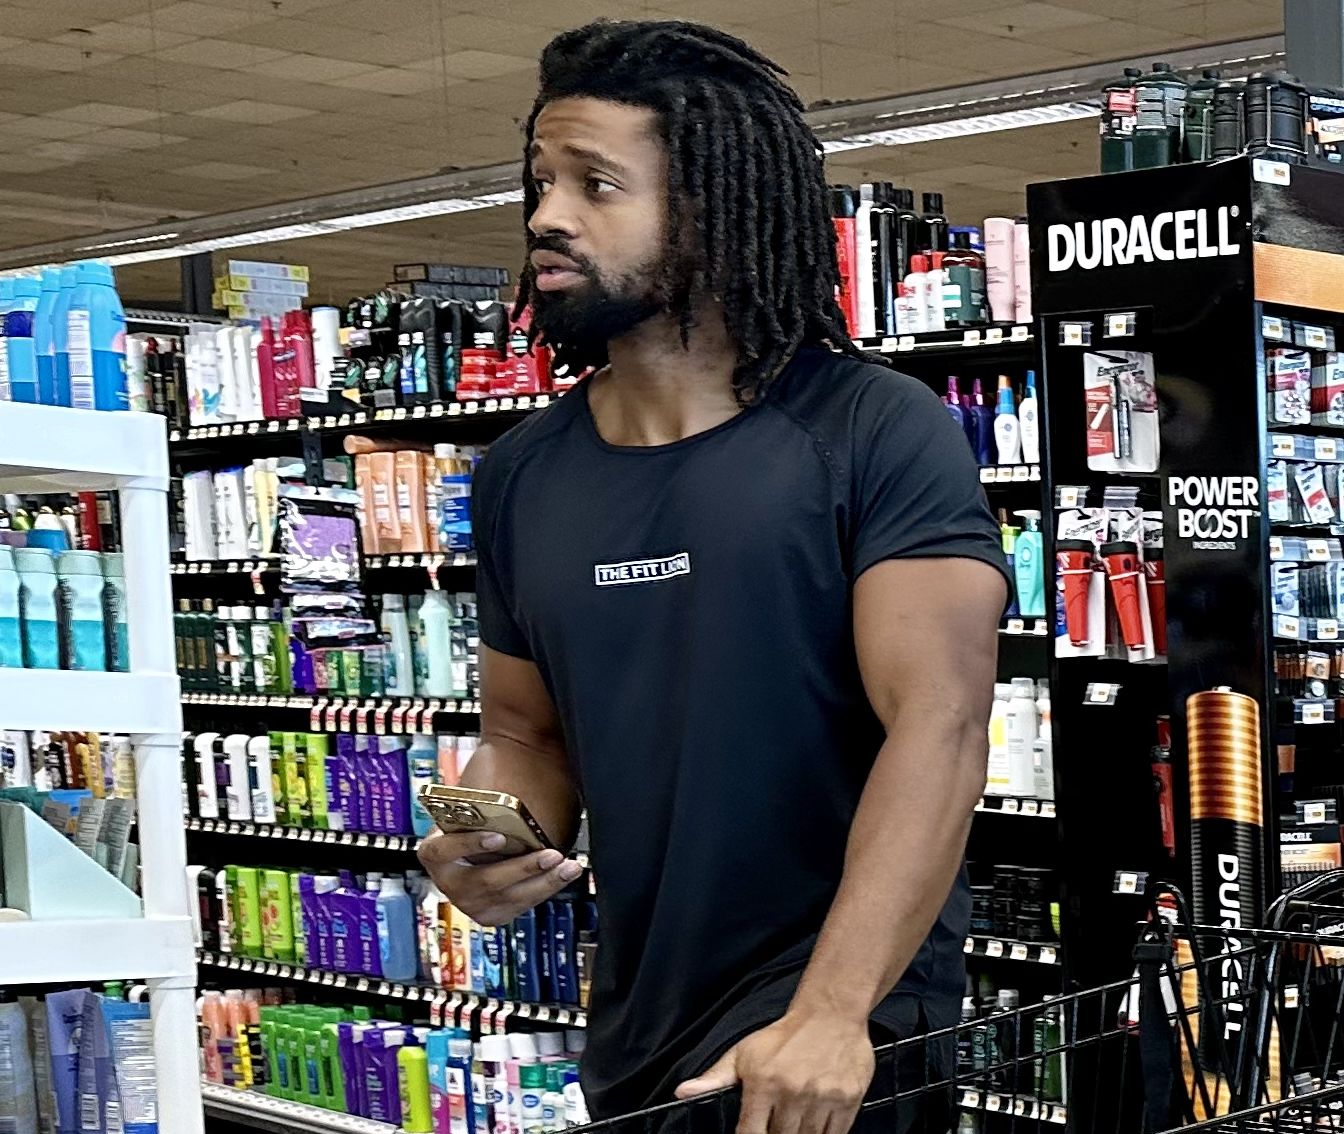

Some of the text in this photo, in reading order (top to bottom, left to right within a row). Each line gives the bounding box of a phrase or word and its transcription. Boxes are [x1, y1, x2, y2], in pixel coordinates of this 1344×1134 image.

[1168, 476, 1259, 506] POWER
[1178, 508, 1252, 540] BOOST
[600, 563, 659, 581] THE FIT
